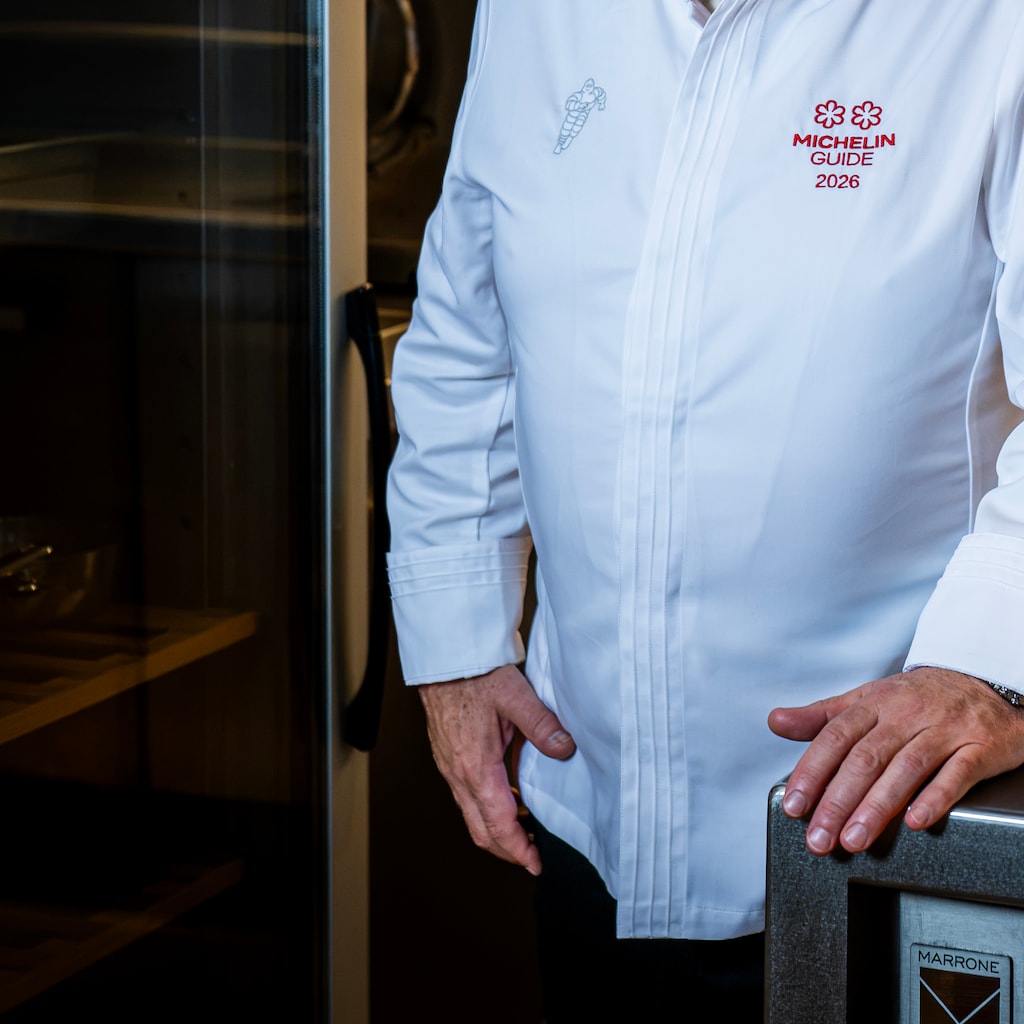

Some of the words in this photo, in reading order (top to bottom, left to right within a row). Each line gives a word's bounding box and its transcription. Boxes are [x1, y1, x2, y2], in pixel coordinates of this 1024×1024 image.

[793, 133, 896, 149] MICHELIN
[810, 151, 874, 166] GUIDE
[815, 173, 860, 189] 2026
[918, 950, 1000, 974] MARRONE
